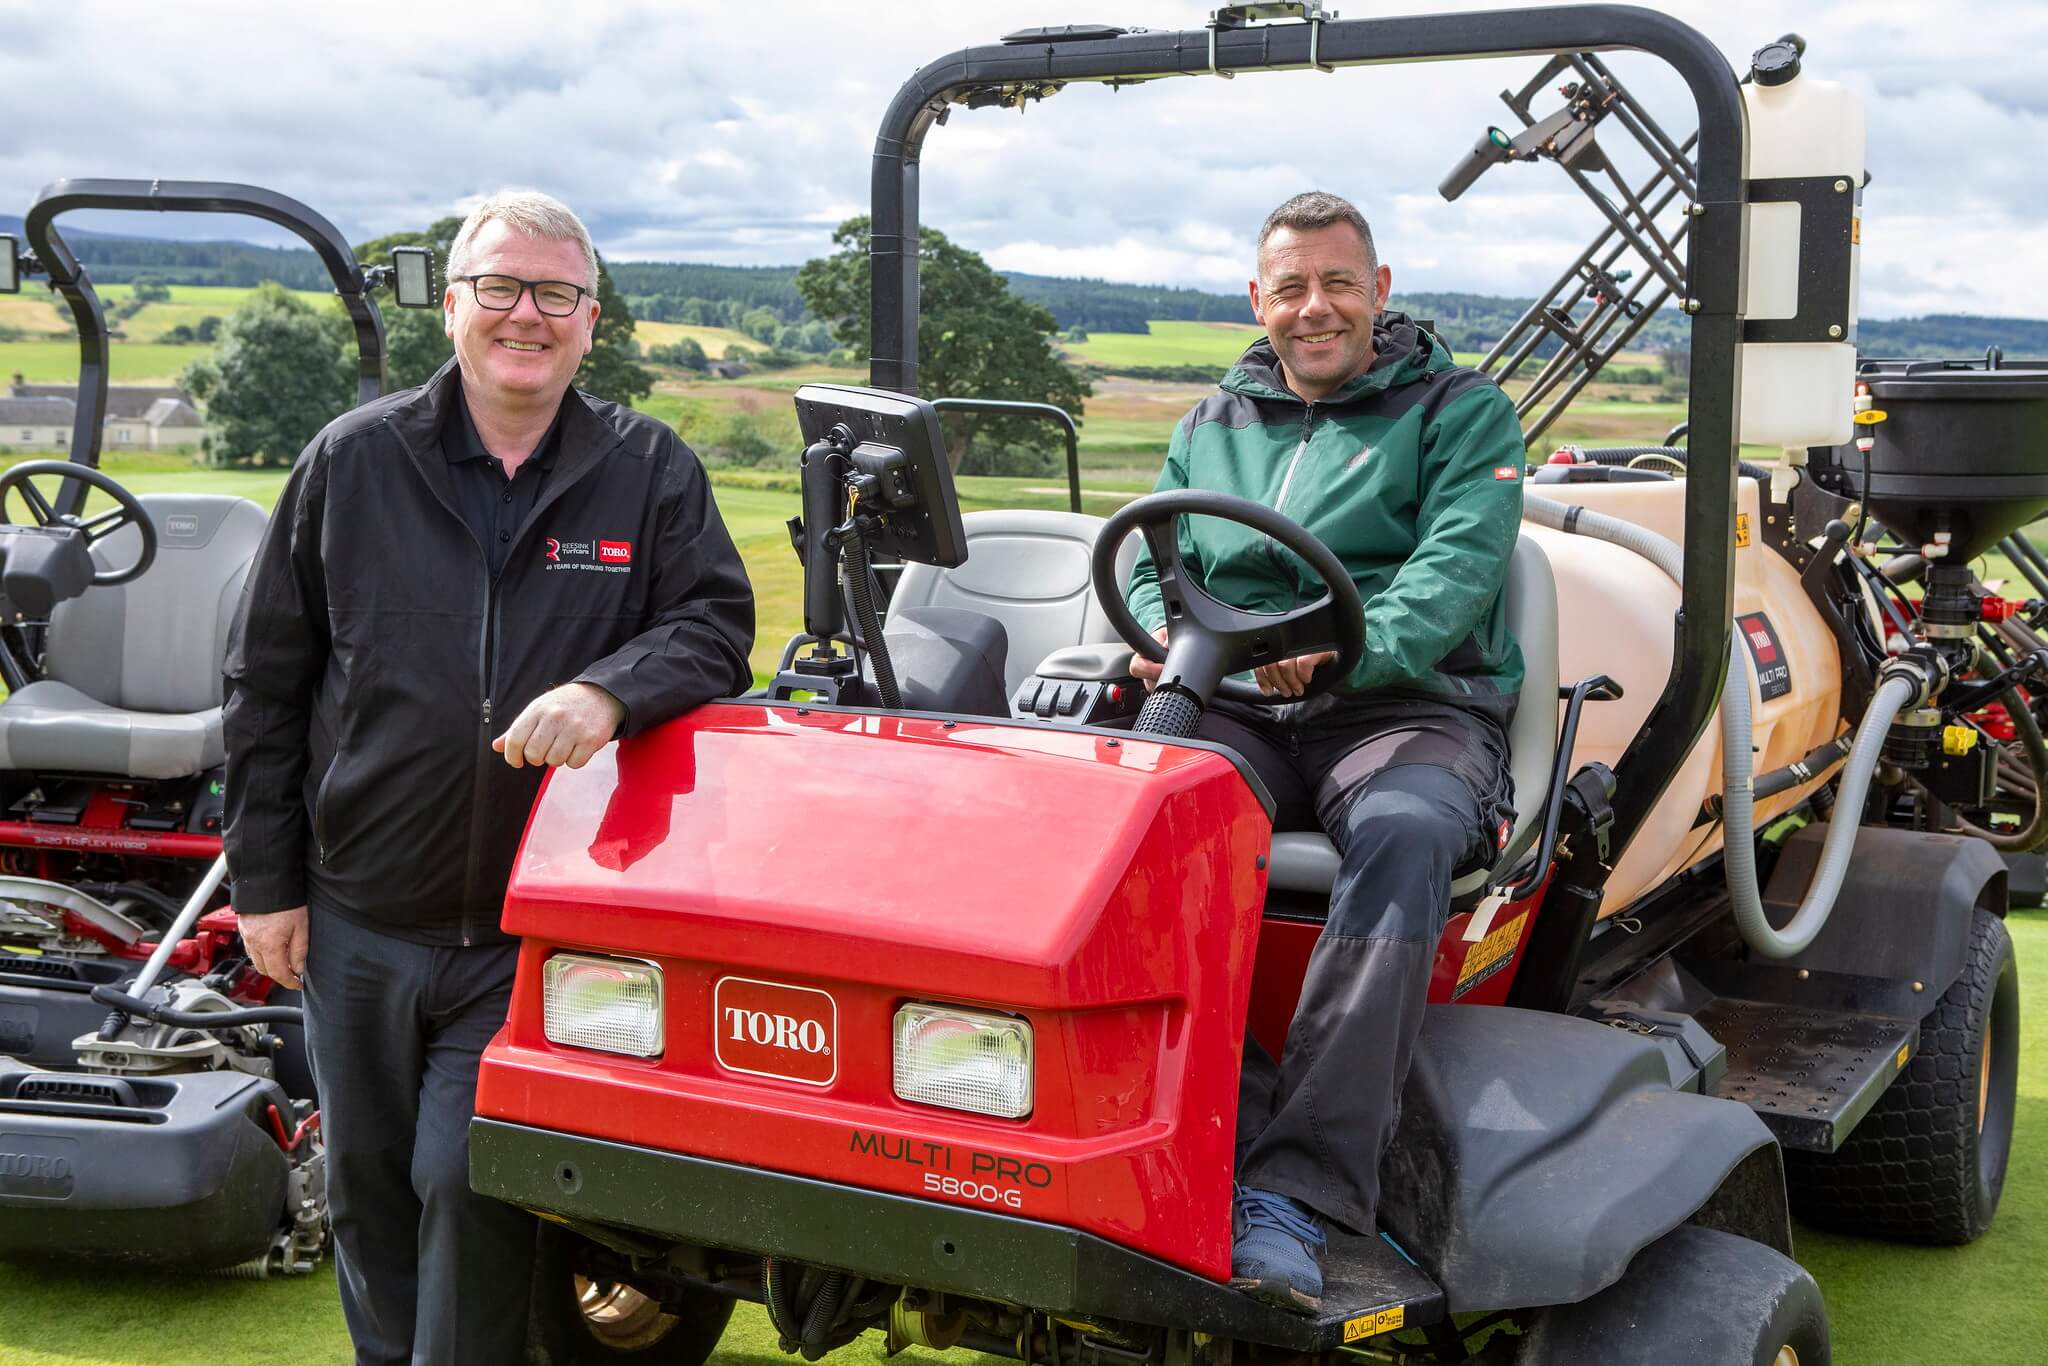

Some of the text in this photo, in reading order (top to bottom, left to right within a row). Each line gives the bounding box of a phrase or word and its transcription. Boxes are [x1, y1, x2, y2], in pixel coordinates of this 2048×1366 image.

[602, 547, 627, 556] TORO
[1750, 630, 1772, 649] TORO
[1759, 666, 1787, 685] MULTI PRO
[850, 1130, 1053, 1189] MULTI PRO
